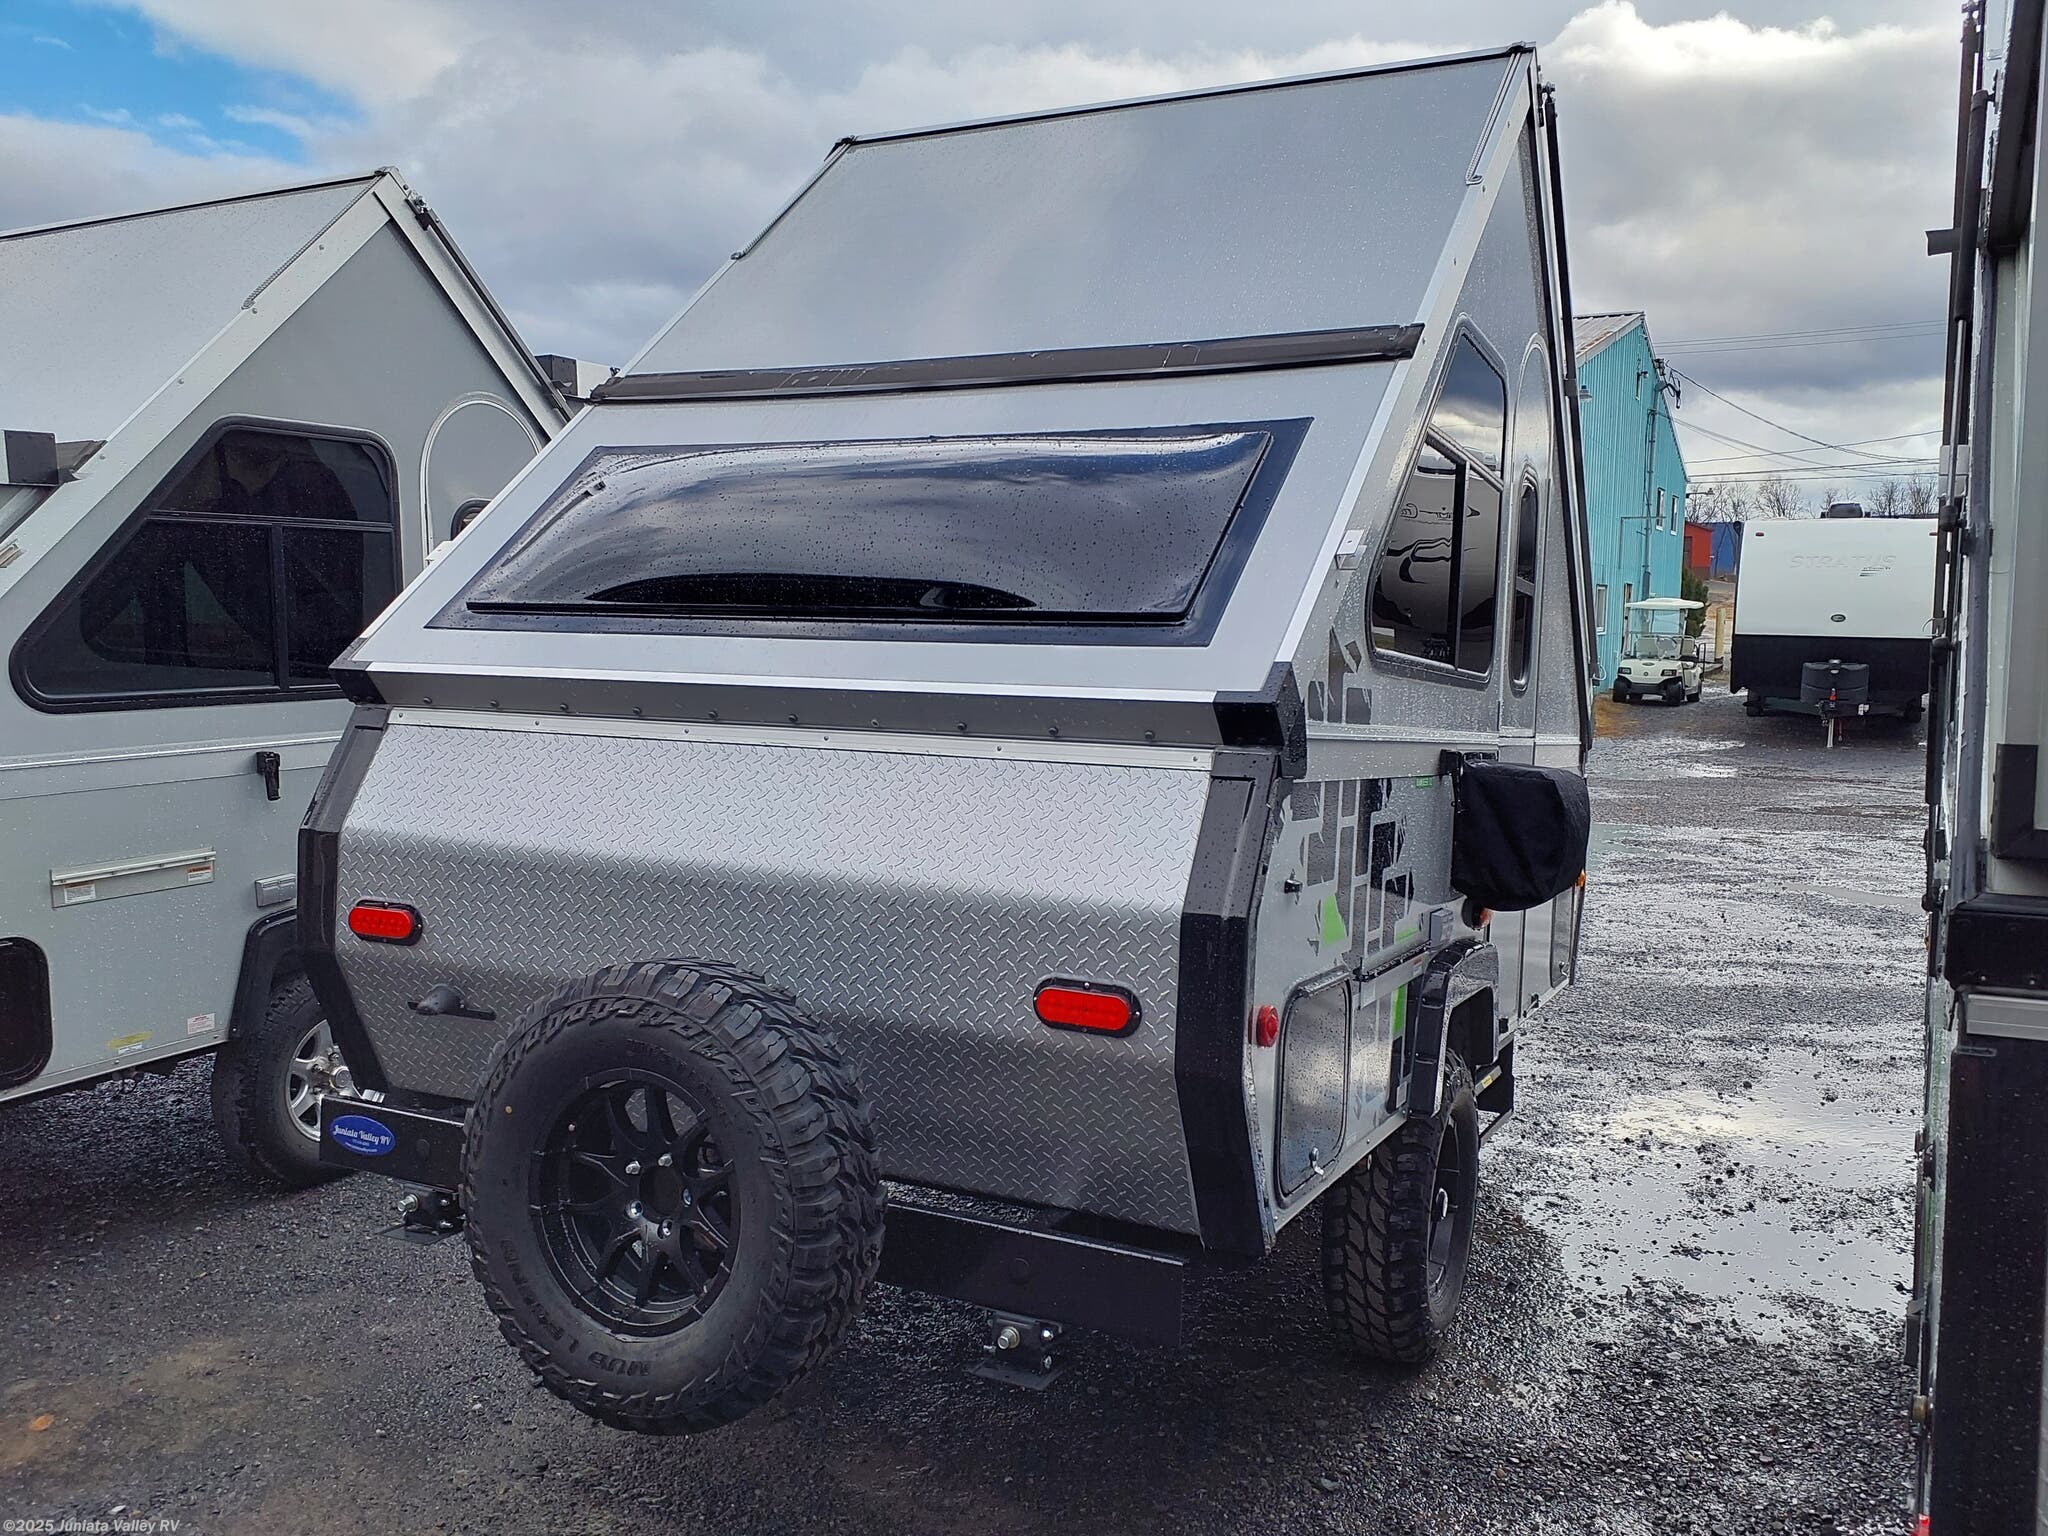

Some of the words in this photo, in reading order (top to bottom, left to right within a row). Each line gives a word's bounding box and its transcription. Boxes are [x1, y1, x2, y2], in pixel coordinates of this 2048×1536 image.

[1789, 554, 1897, 569] STRATUS
[359, 1130, 379, 1145] Valley
[380, 1135, 391, 1146] RV
